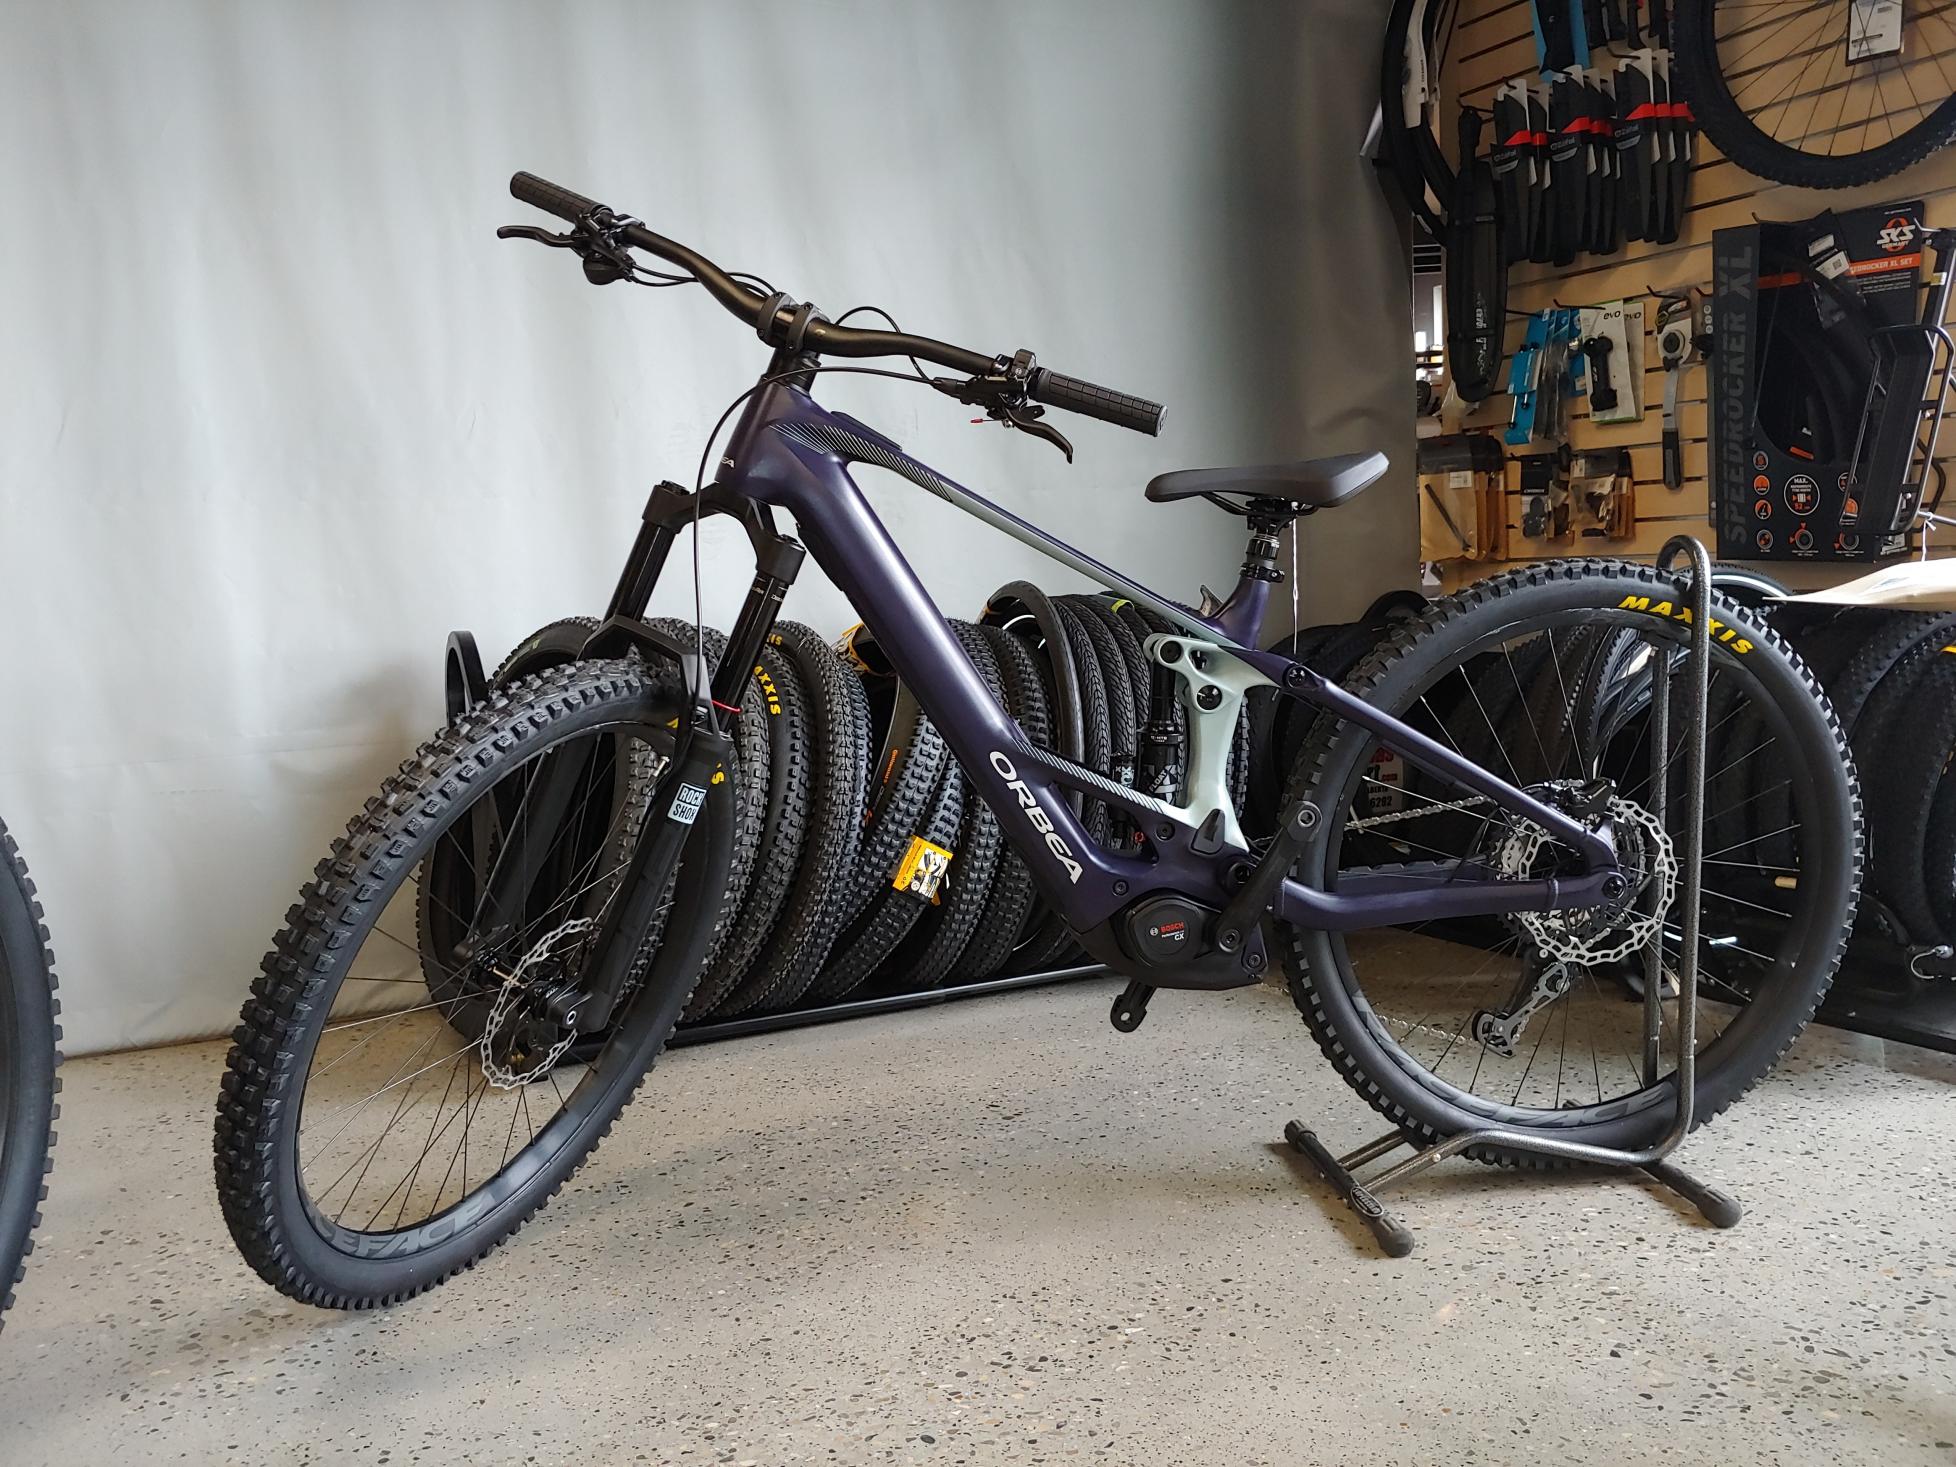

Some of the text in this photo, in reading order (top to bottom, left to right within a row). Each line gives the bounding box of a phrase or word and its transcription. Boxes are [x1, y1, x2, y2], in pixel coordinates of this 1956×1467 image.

[1877, 225, 1916, 245] SKS
[1603, 310, 1621, 320] evo
[1718, 245, 1753, 546] SPEEDROCKER XL
[1618, 595, 1754, 654] MAXXIS
[753, 665, 782, 716] AXXIS
[1149, 769, 1168, 792] FLOAT
[679, 786, 706, 806] ROCK
[989, 750, 1084, 885] ORBEA
[1160, 921, 1185, 933] BOSCH
[1174, 932, 1185, 941] CX
